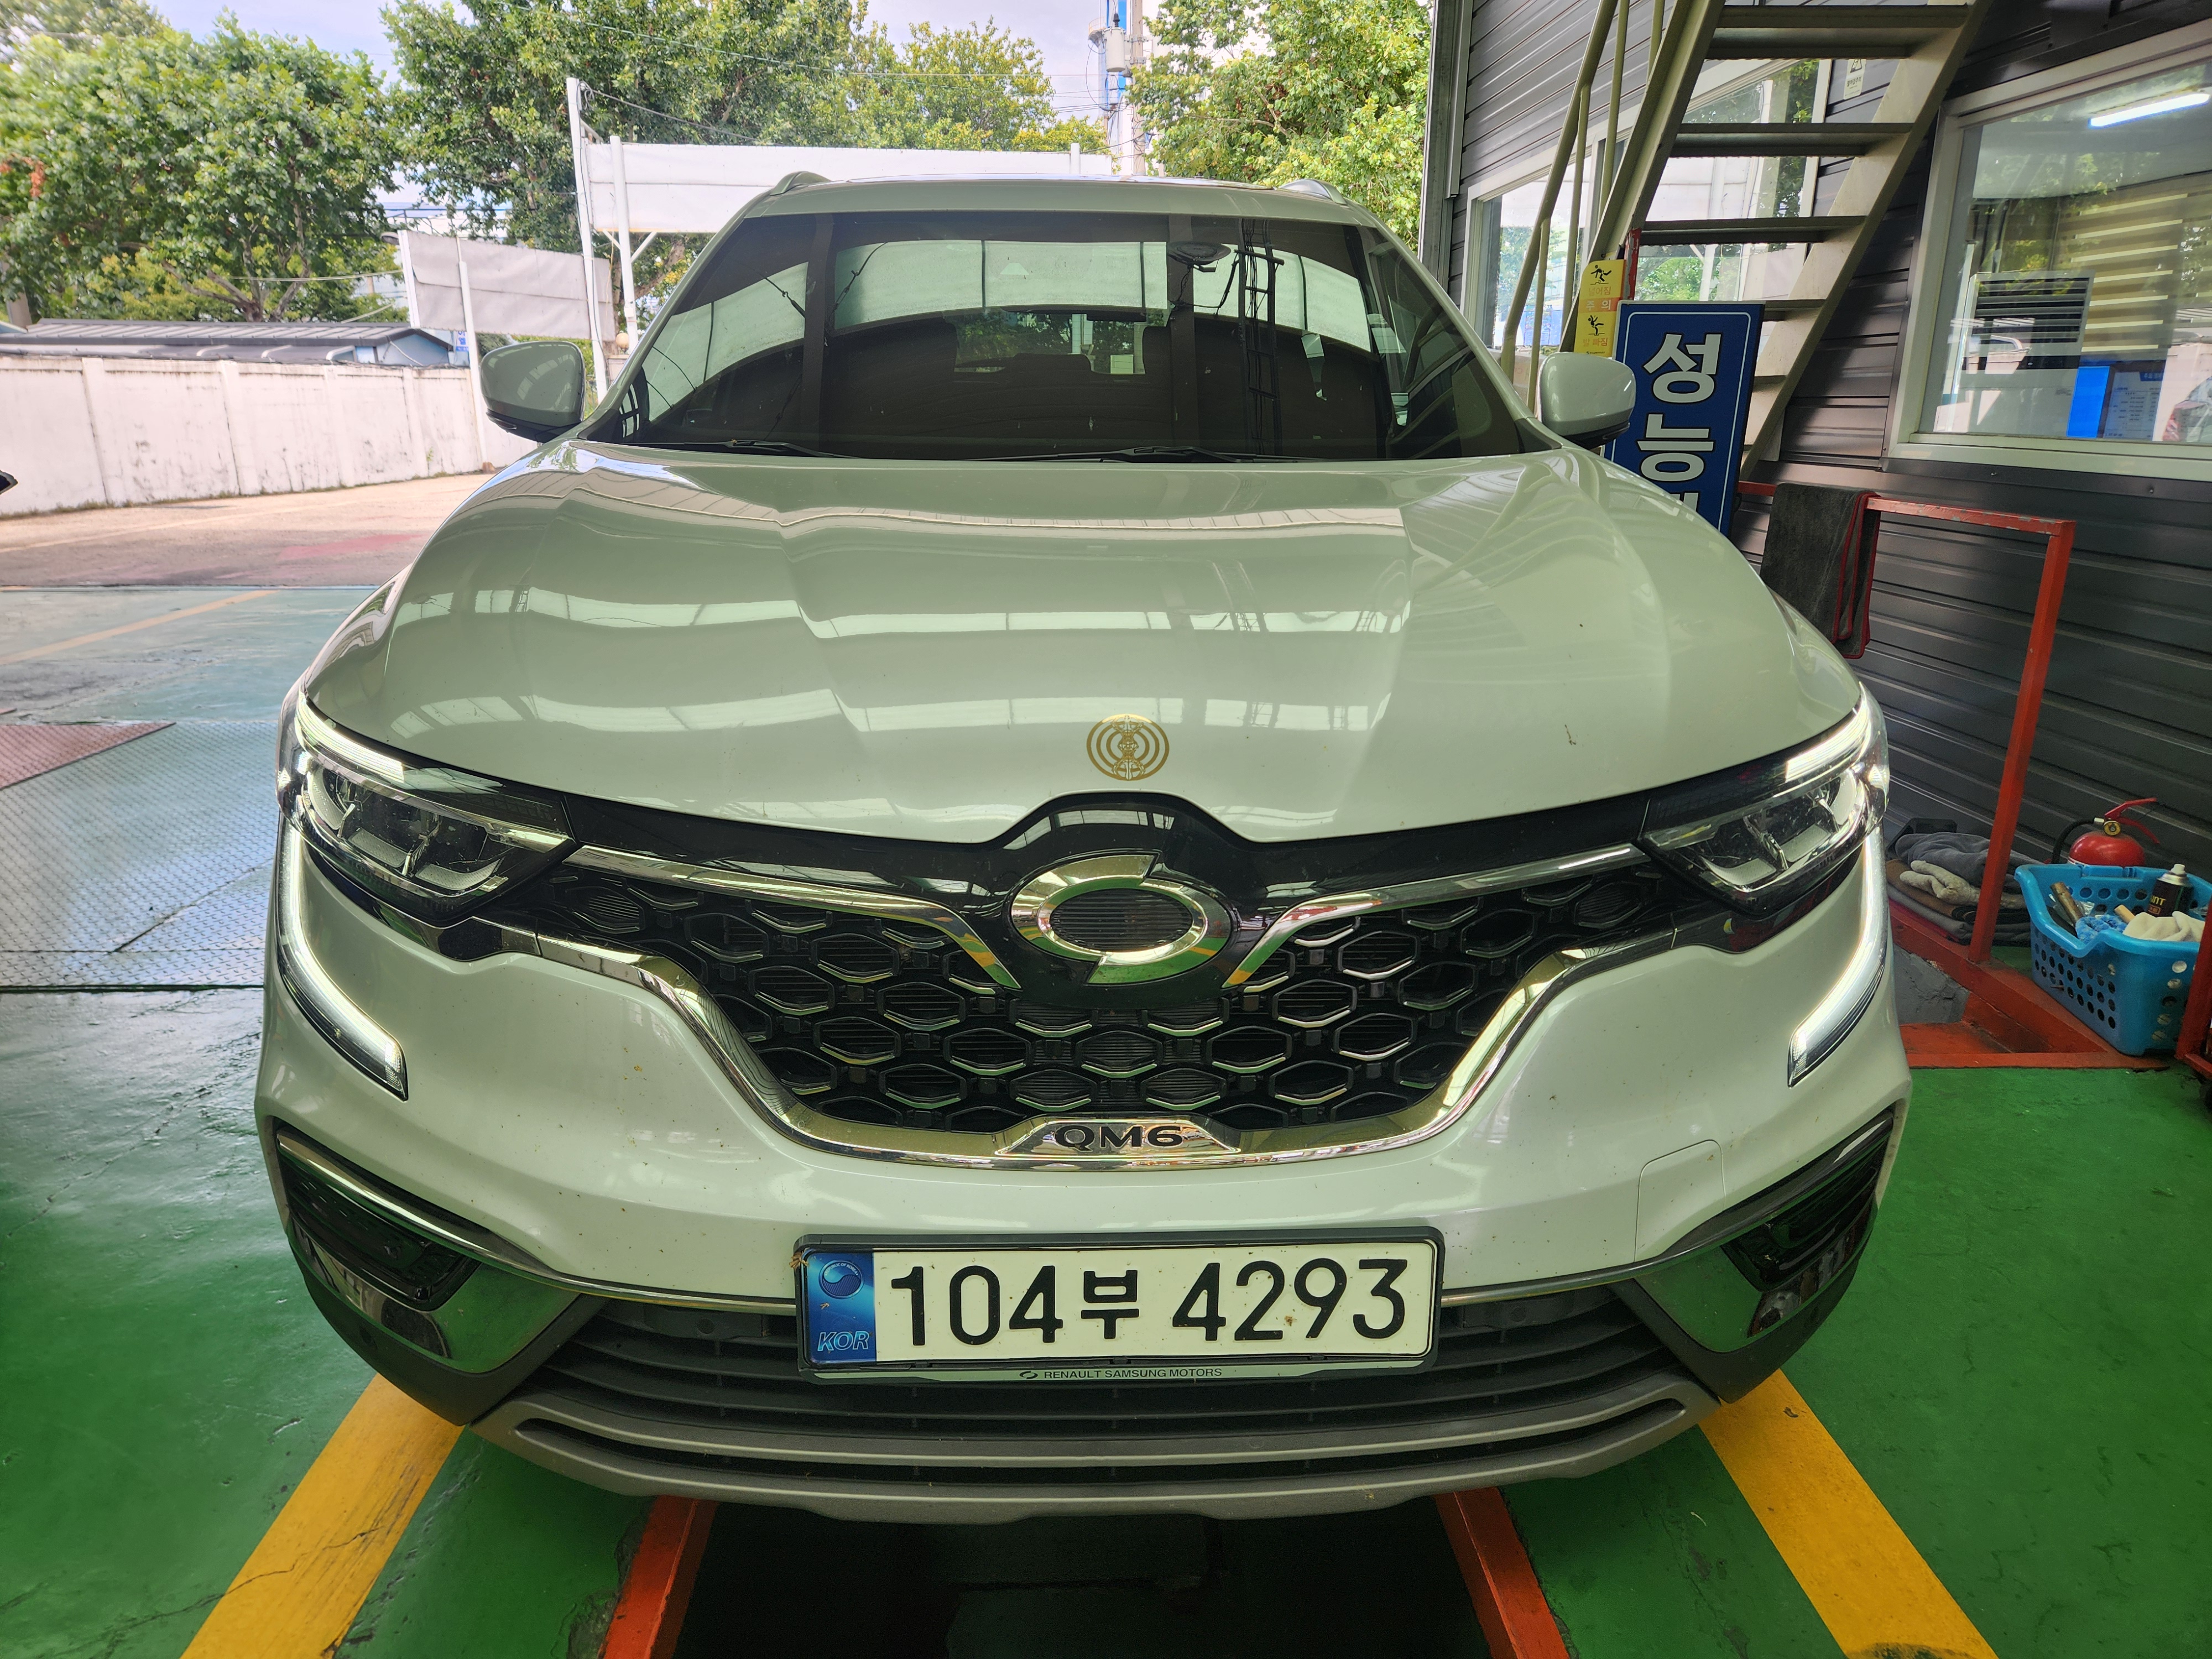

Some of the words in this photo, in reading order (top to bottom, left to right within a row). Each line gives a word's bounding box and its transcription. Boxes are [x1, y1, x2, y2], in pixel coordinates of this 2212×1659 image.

[1589, 286, 1611, 296] 넘어짐
[1586, 300, 1595, 311] 주
[1601, 299, 1611, 310] 의
[1583, 338, 1590, 347] 발
[1593, 338, 1608, 347] 빠짐
[1637, 334, 1721, 512] 성능
[2151, 895, 2166, 906] INT
[1055, 1125, 1183, 1152] QM6
[846, 1264, 858, 1275] KOREA
[891, 1265, 1140, 1345] 104부
[1172, 1258, 1408, 1341] 4293
[817, 1331, 870, 1352] KOR
[1044, 1370, 1102, 1379] RENAULT
[1104, 1369, 1166, 1378] SAMSUNG
[1169, 1368, 1223, 1378] MOTORS
